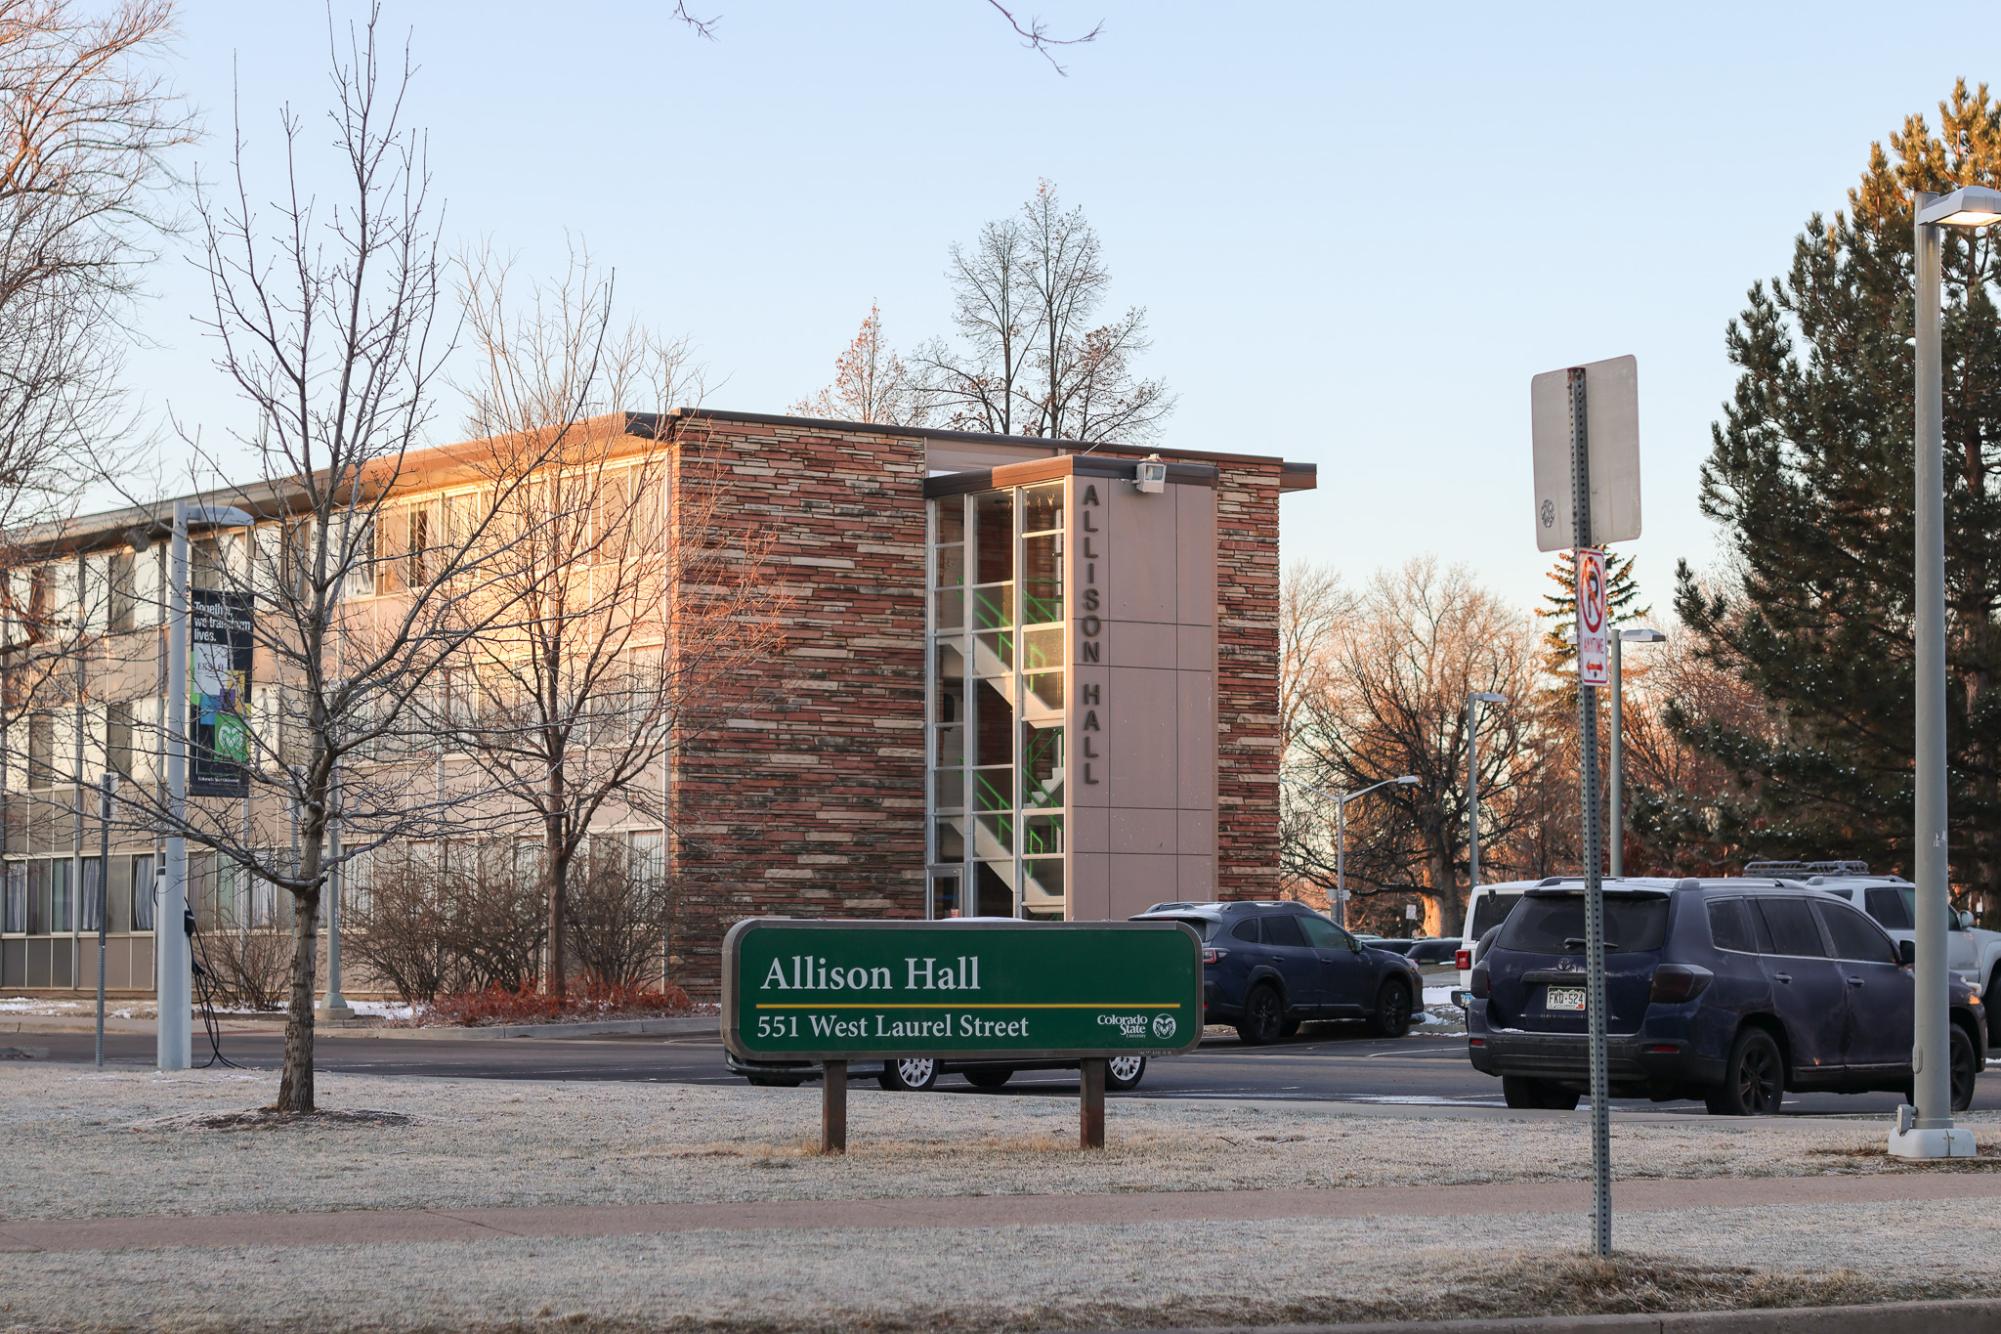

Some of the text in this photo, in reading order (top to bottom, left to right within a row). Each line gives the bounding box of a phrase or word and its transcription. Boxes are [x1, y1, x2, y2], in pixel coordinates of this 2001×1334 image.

[194, 628, 217, 641] lives.
[1081, 483, 1101, 786] ALLISON HALL
[760, 955, 981, 990] Allison Hall
[757, 1013, 1029, 1038] 551 West Laurel Street
[1097, 1014, 1148, 1024] Colorado
[1120, 1023, 1146, 1035] State
